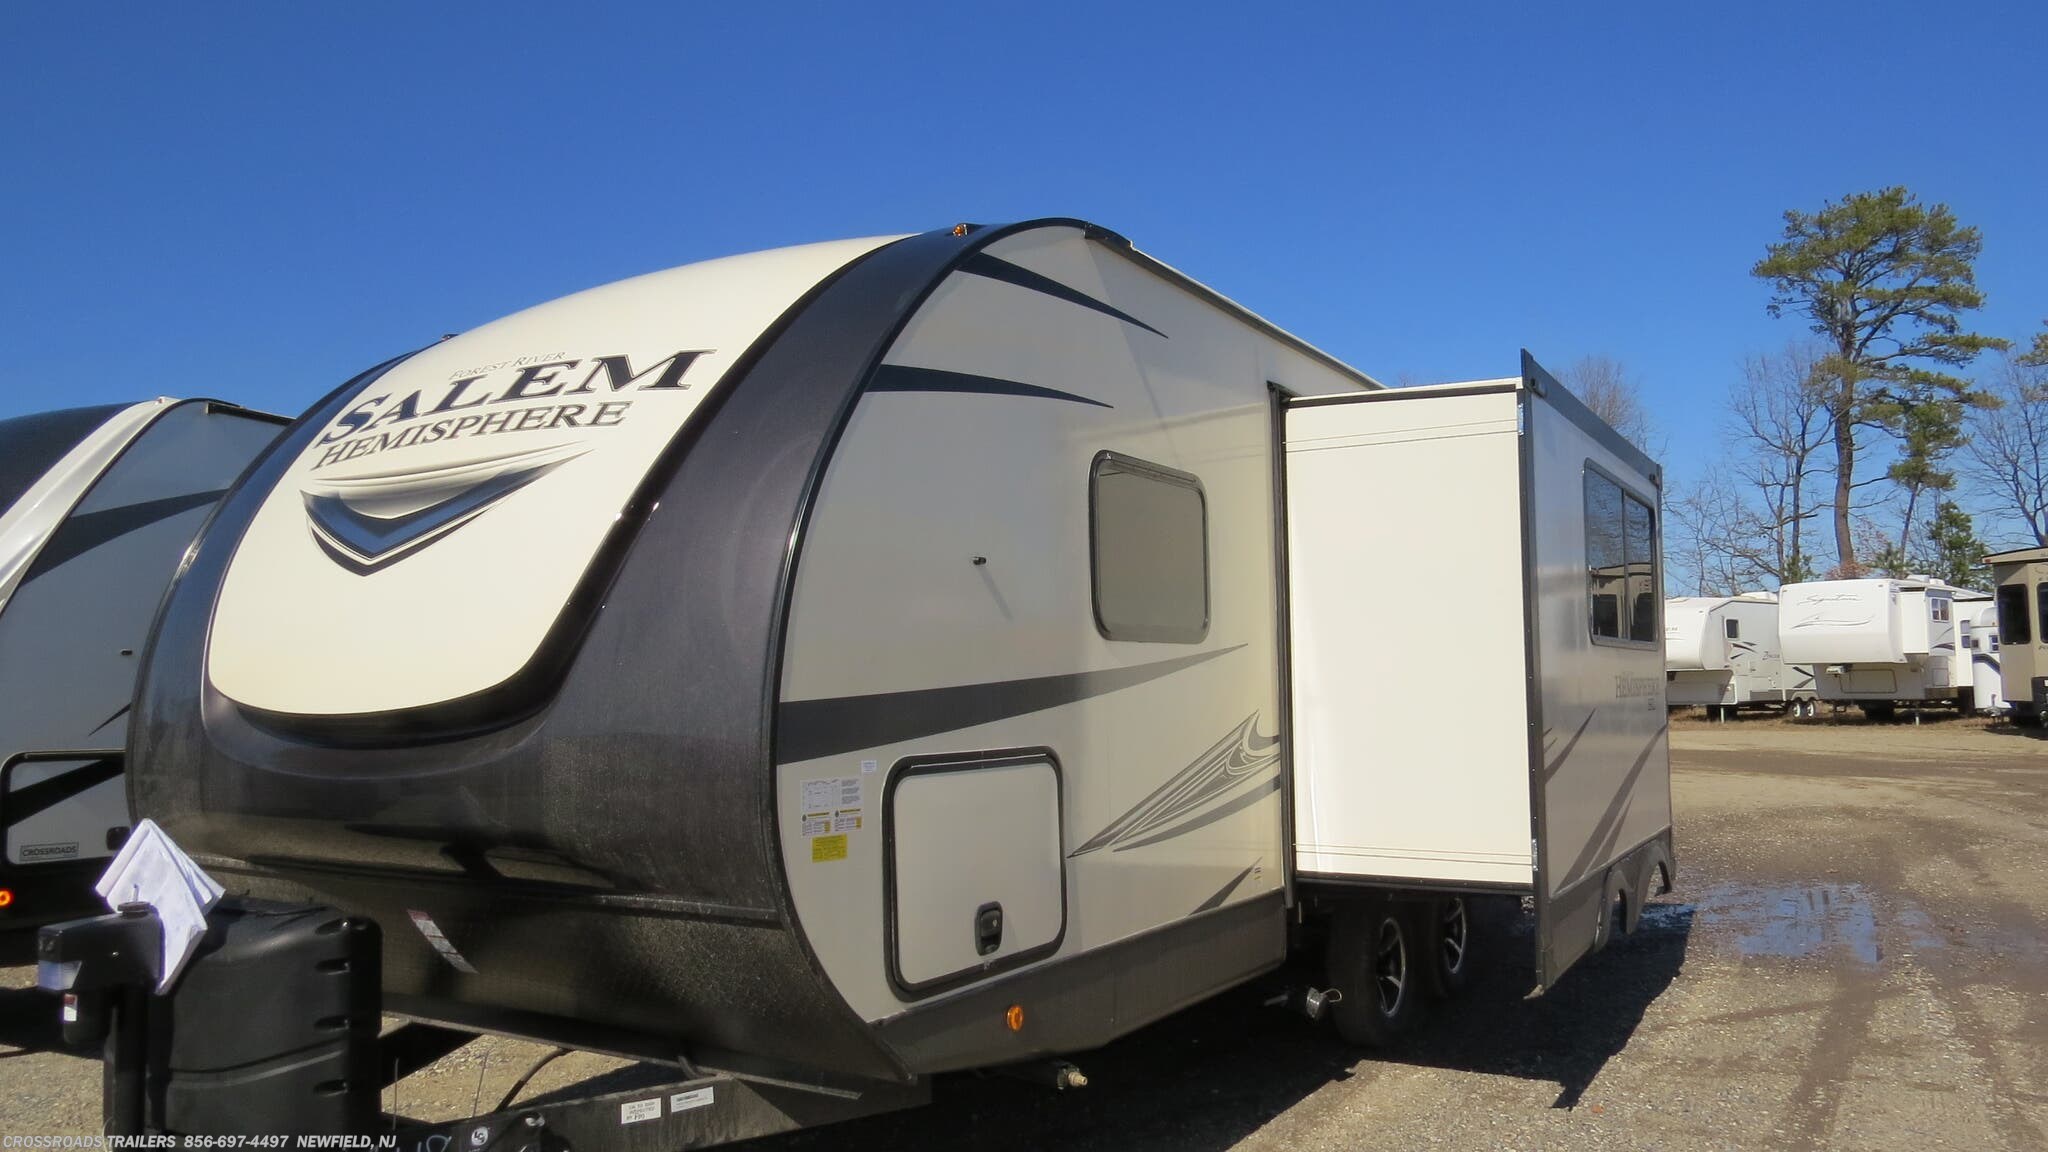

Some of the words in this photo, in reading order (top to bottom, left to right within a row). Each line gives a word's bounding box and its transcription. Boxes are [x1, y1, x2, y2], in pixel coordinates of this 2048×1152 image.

[315, 348, 718, 448] SALEM
[448, 361, 511, 380] FOREST
[511, 352, 566, 367] RIVER
[310, 400, 634, 471] HEMISPHERE
